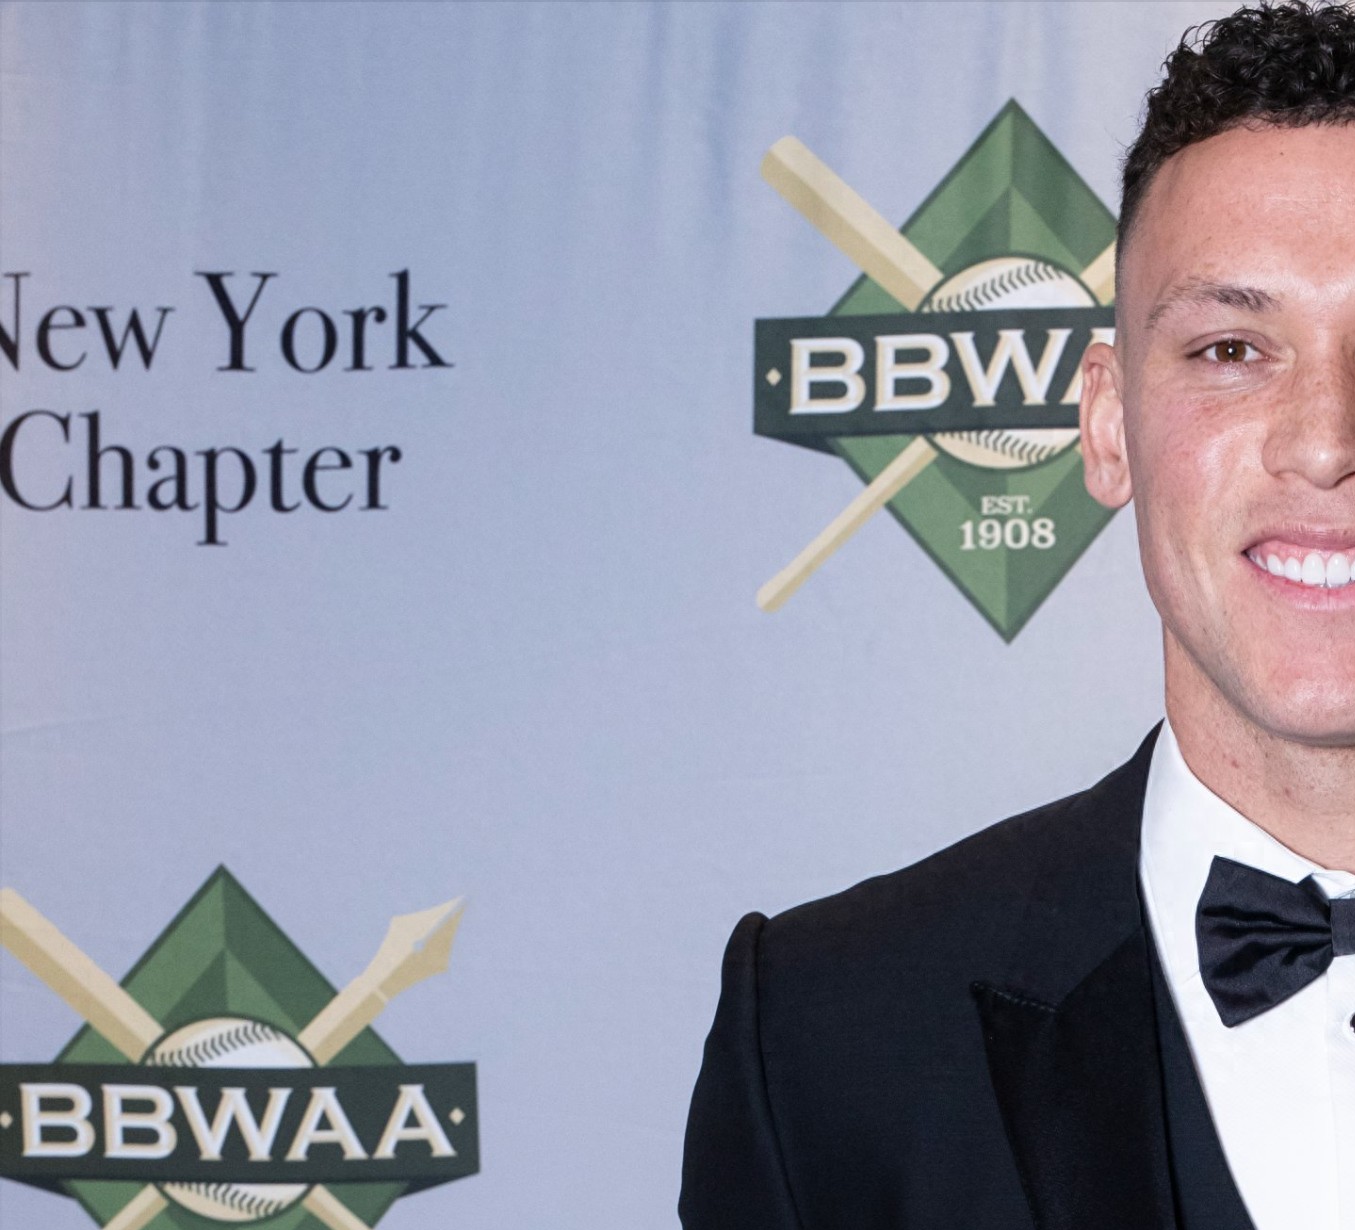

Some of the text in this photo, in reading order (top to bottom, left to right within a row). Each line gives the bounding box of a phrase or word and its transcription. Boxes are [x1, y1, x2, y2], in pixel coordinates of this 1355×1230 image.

[194, 269, 454, 373] York
[789, 328, 1116, 415] BBW
[0, 410, 401, 545] Chapter
[980, 495, 1034, 515] EST.
[959, 518, 1056, 551] 1908
[19, 1082, 456, 1161] BBWAA
